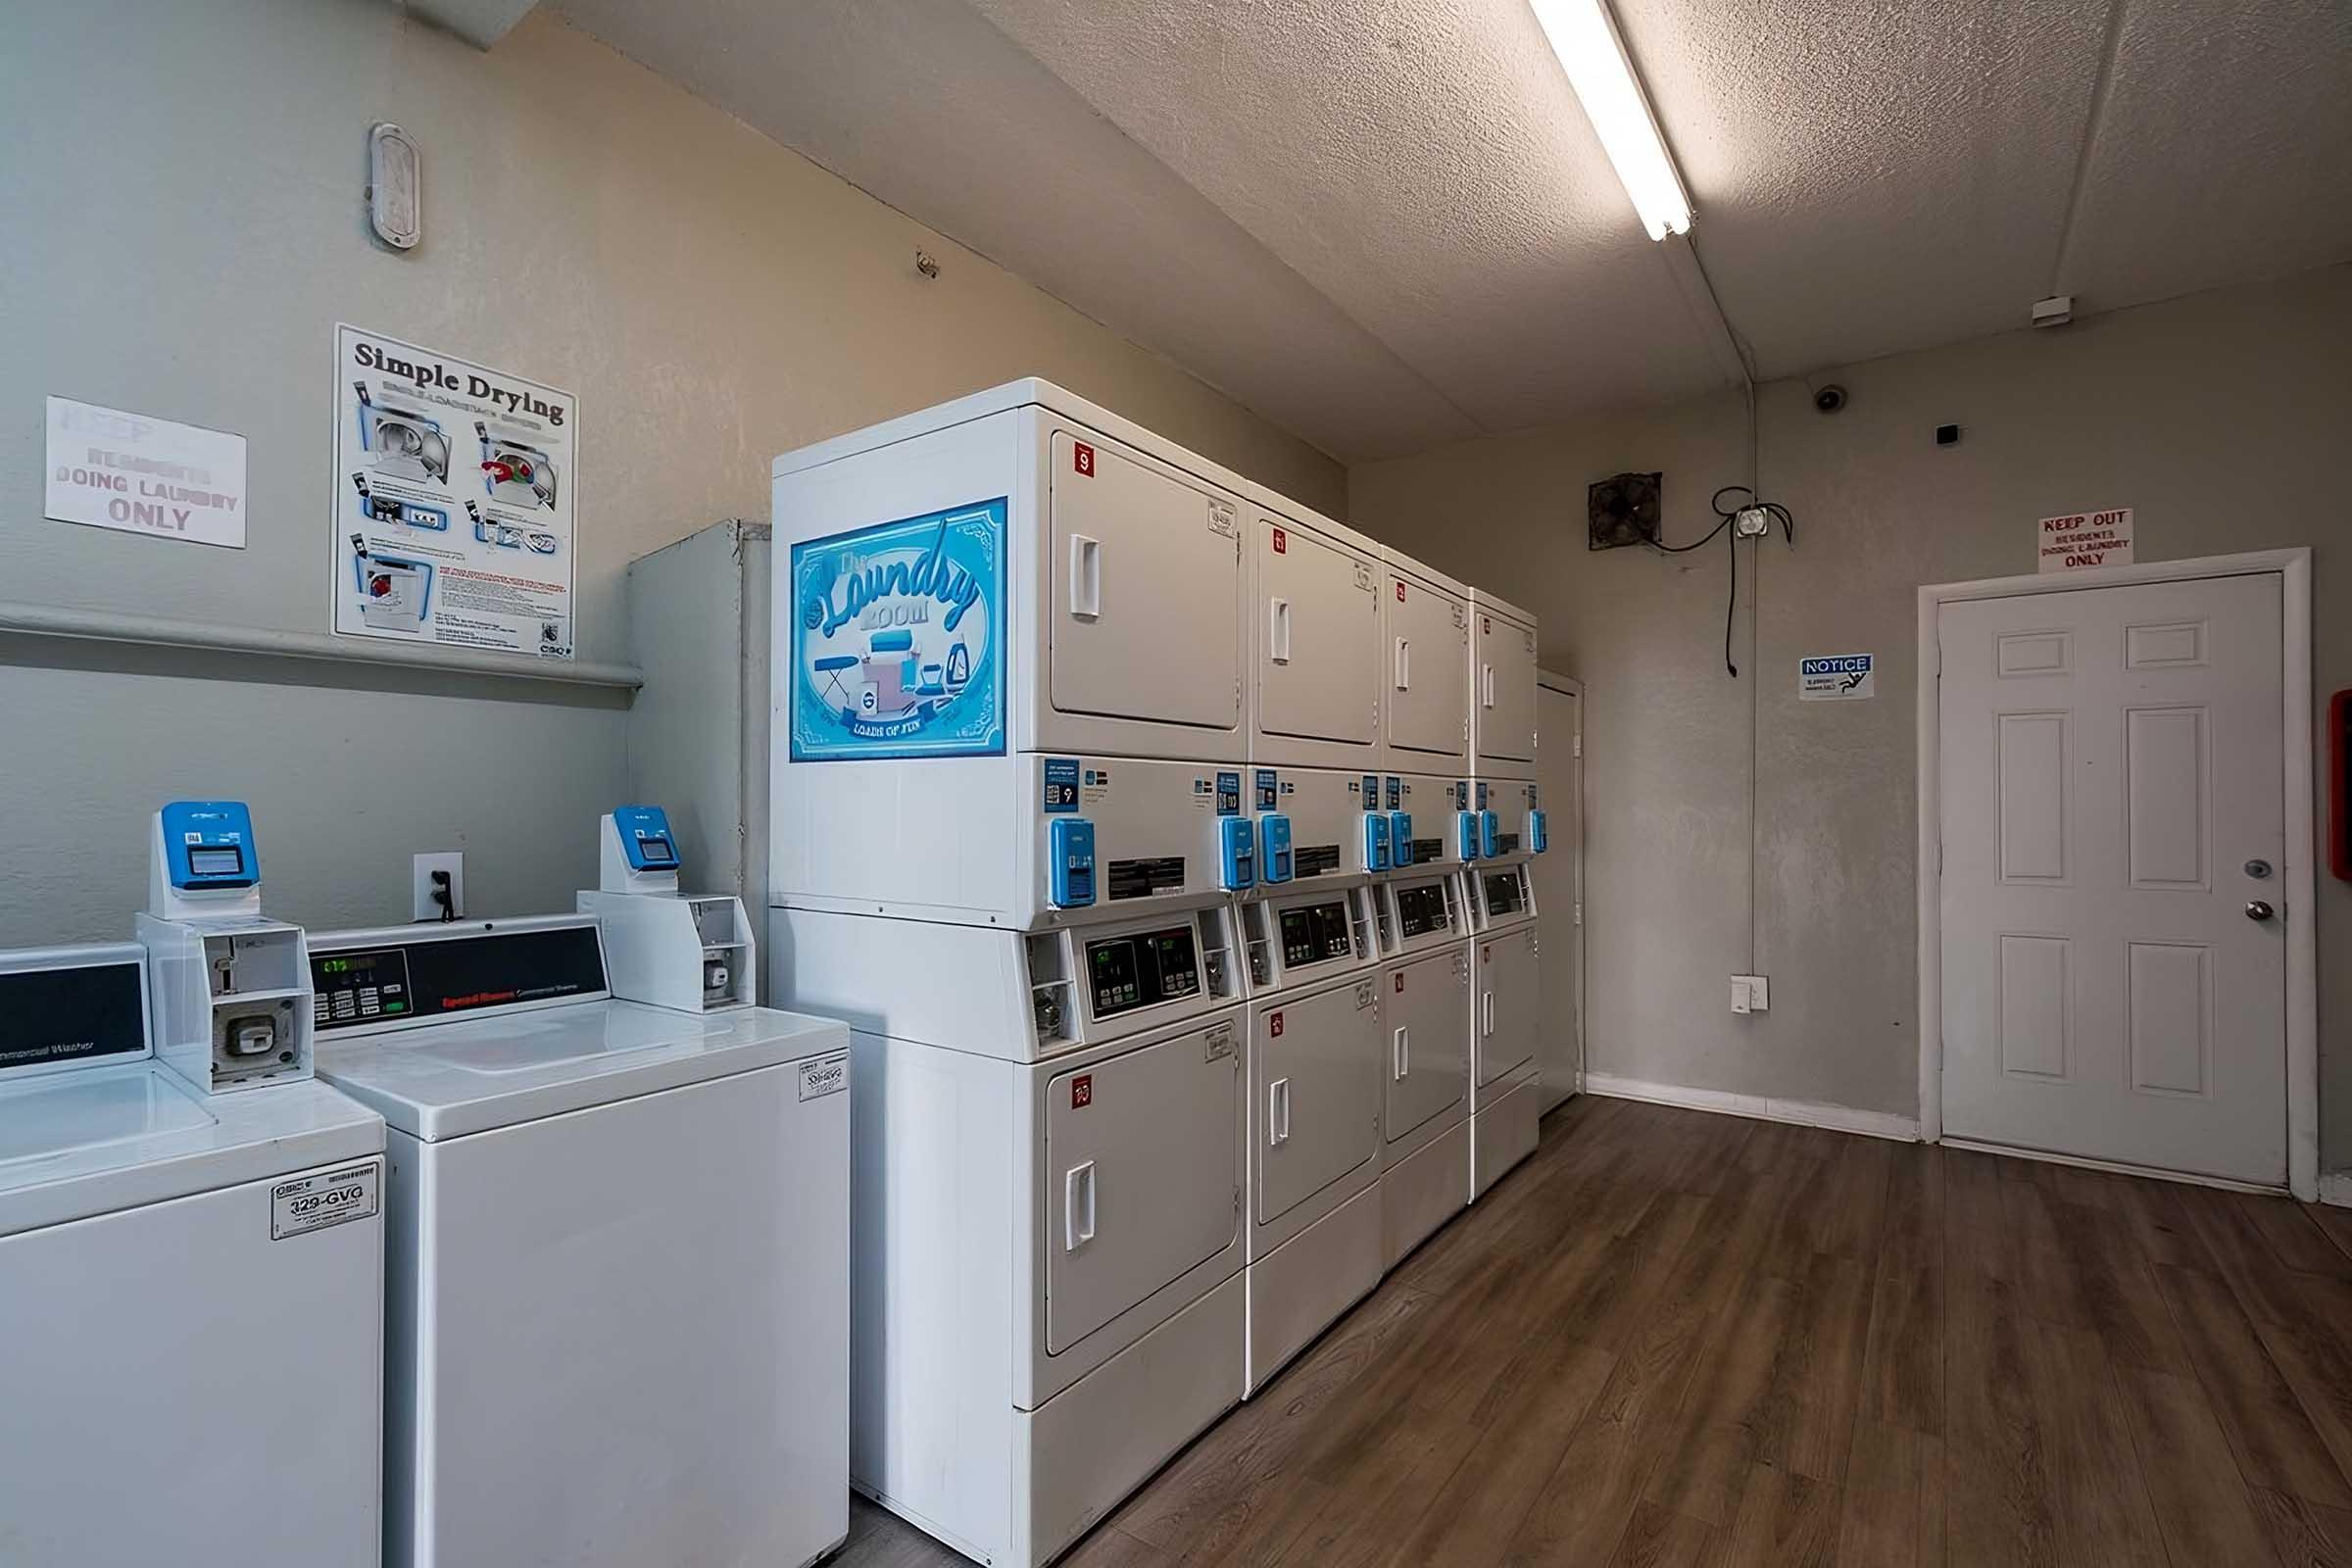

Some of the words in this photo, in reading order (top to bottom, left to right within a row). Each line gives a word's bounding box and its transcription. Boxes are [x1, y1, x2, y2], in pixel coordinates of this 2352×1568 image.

[354, 343, 460, 391] Simple
[466, 374, 564, 425] Drying
[56, 466, 128, 493] DOING
[108, 497, 191, 531] ONLY
[2043, 515, 2085, 532] KEEP
[2093, 511, 2128, 526] OUT
[2065, 552, 2105, 567] ONLY
[821, 516, 980, 639] Laundry
[1806, 658, 1867, 674] NOTICE
[885, 724, 900, 737] OF
